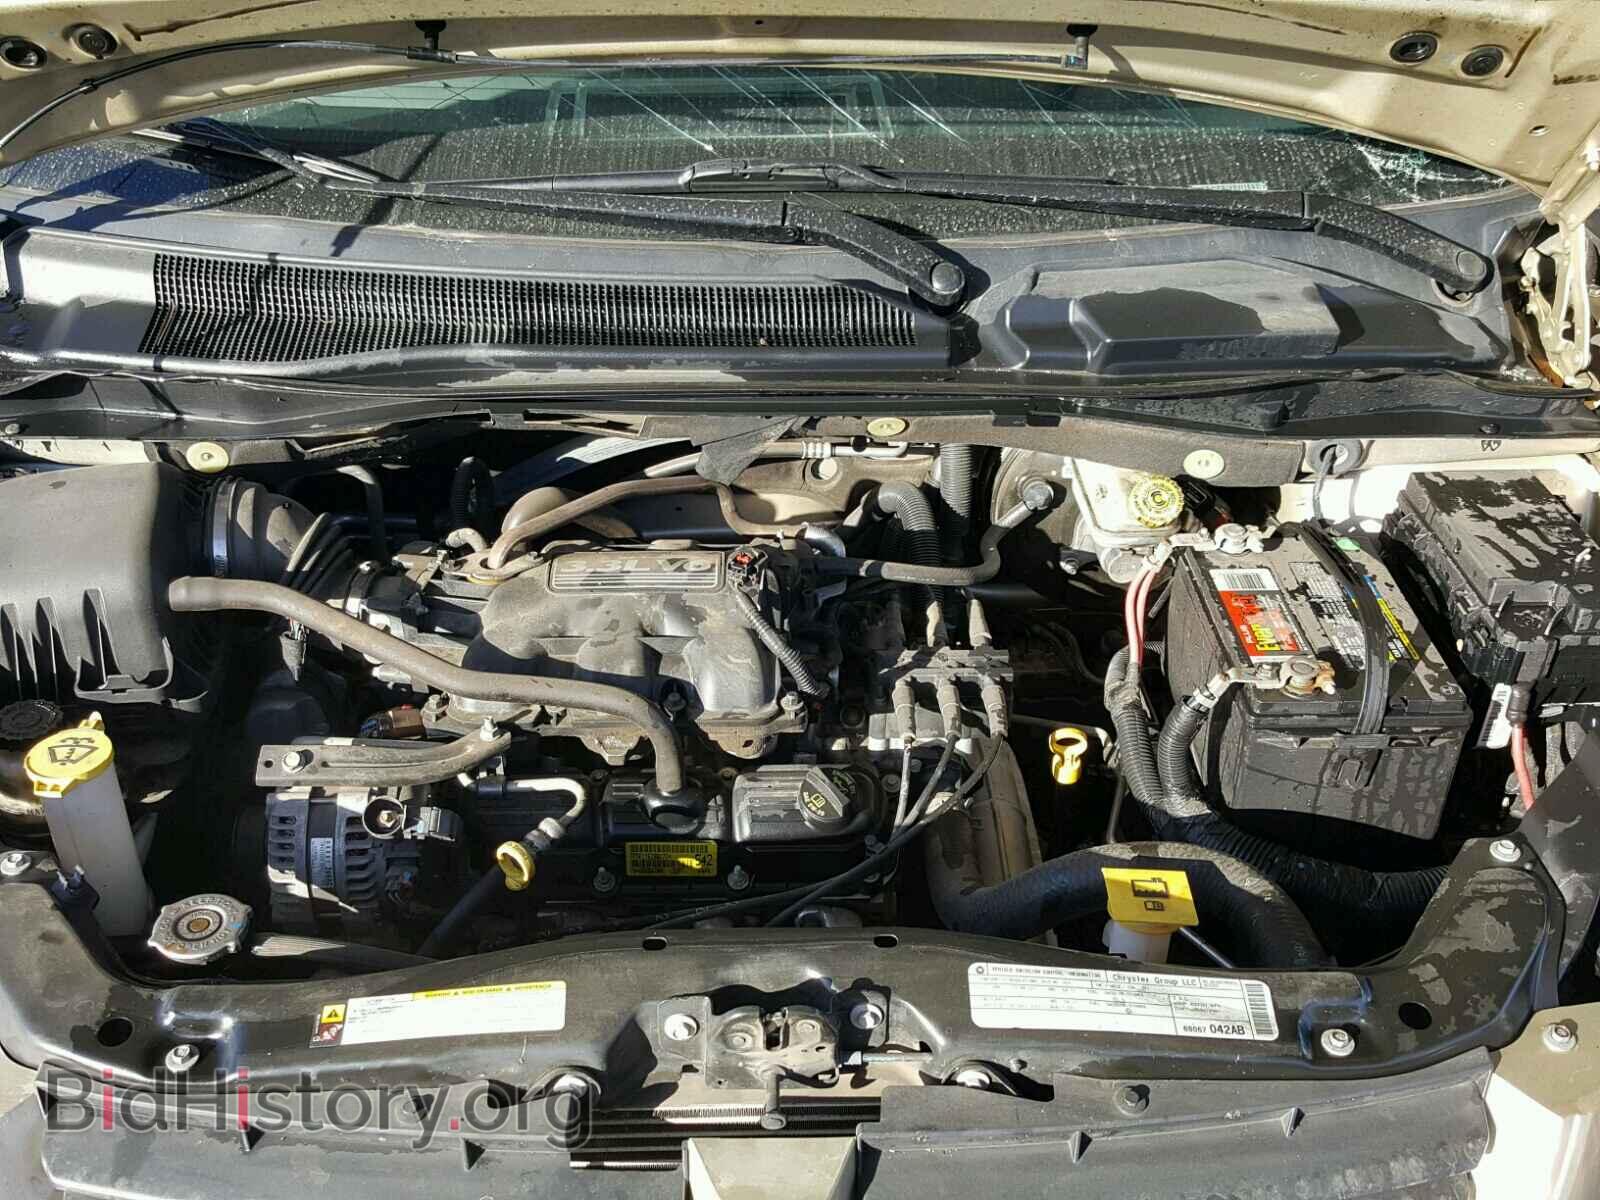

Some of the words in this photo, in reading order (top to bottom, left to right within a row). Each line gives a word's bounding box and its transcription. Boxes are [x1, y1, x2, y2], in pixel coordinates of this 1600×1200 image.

[559, 559, 650, 572] 3.3L
[658, 558, 714, 572] V6
[1112, 973, 1149, 984] Chrysler
[1154, 976, 1178, 987] Group
[1182, 978, 1197, 986] LLC
[1209, 1024, 1245, 1036] 042AB
